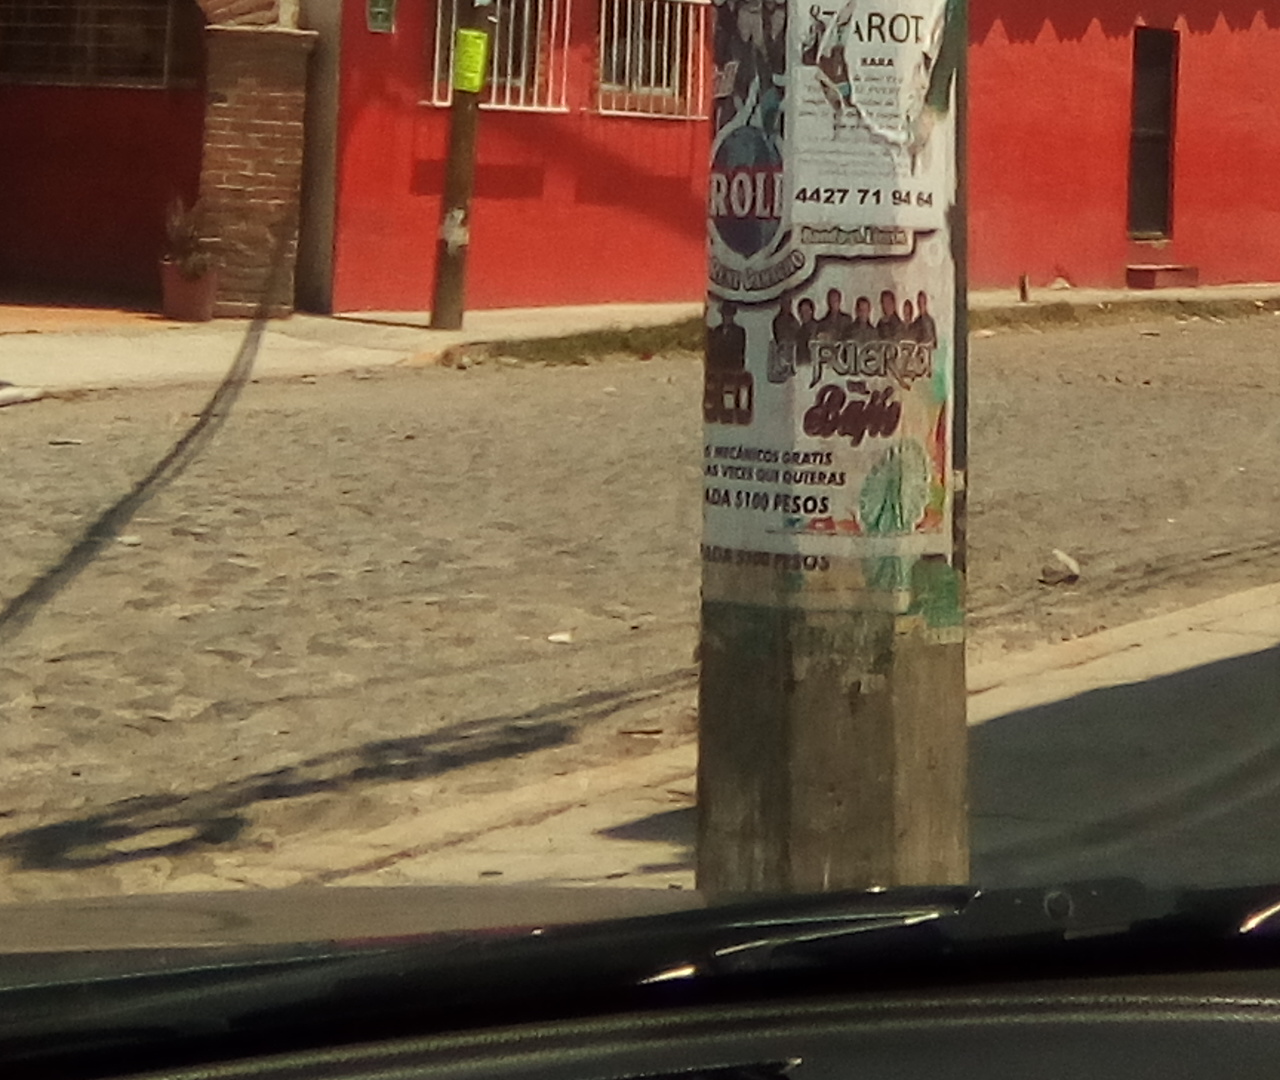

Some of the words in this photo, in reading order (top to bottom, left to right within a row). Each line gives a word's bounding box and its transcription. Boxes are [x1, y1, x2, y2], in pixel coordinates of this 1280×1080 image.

[794, 186, 850, 205] 4427
[857, 188, 882, 206] 71
[782, 451, 833, 466] GRATIS
[782, 470, 847, 487] QUIERAS
[736, 490, 769, 512] $100
[773, 493, 829, 514] PESOS
